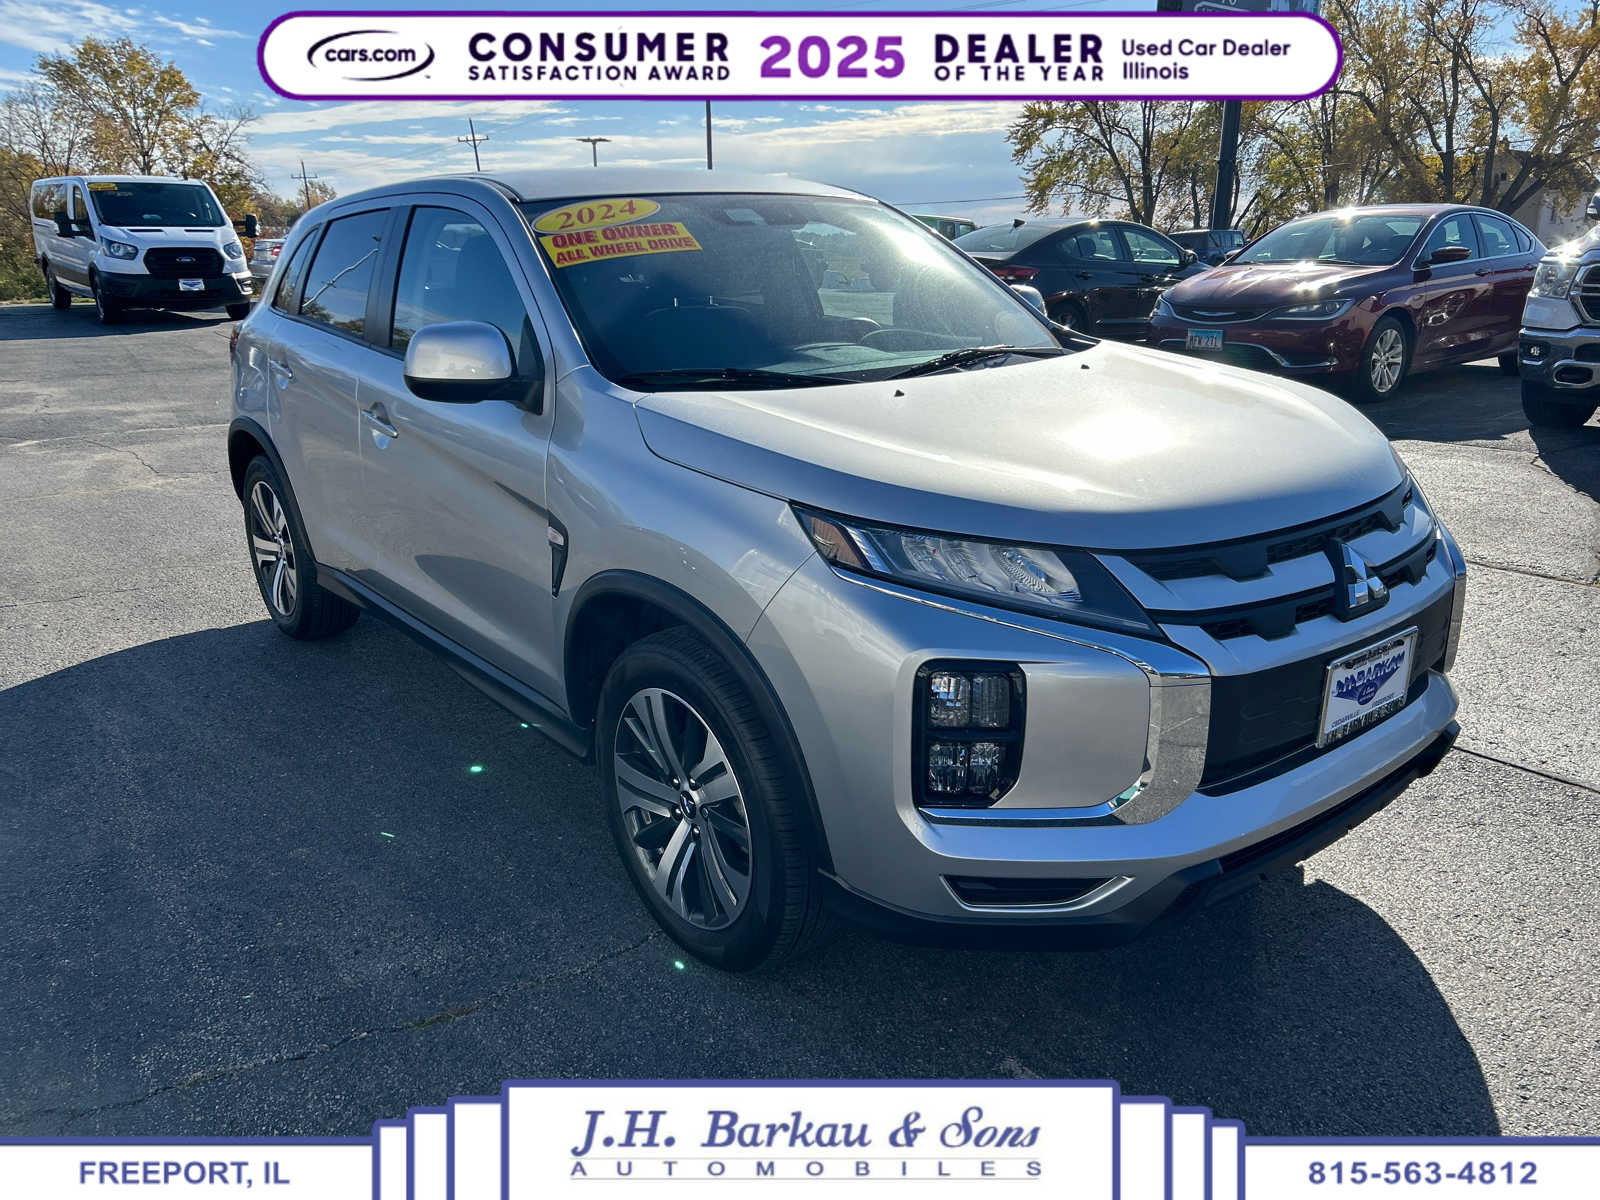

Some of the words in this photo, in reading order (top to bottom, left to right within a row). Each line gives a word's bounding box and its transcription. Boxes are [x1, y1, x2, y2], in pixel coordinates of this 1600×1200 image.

[556, 199, 638, 230] 2024
[552, 231, 599, 249] ONE
[602, 223, 680, 242] OWNER
[556, 249, 590, 265] ALL
[591, 241, 648, 258] WHEEL
[648, 236, 697, 251] DRIVE
